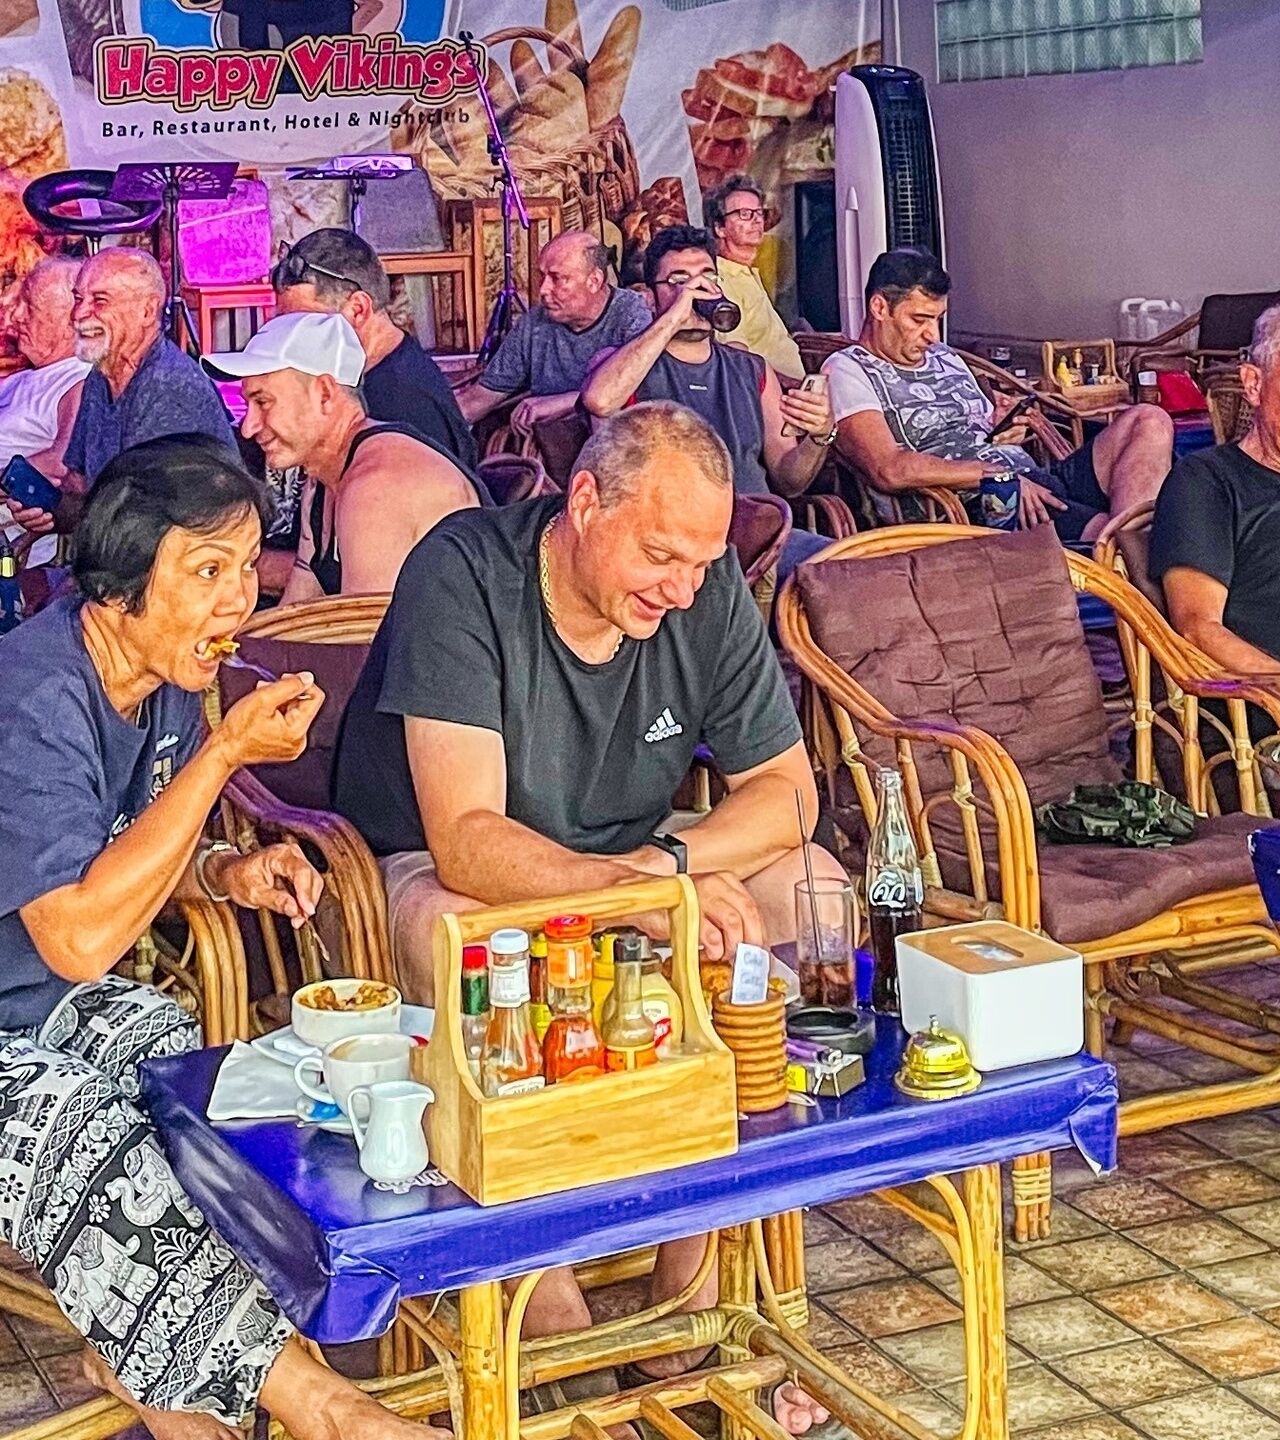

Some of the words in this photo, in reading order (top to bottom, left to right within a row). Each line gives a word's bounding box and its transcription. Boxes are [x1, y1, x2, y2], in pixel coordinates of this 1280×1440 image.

[102, 44, 281, 106] Happy
[289, 37, 483, 98] Vikings
[102, 122, 144, 138] Bar,
[152, 117, 277, 136] Restaurant,
[285, 113, 340, 130] Hotel
[348, 113, 361, 127] &
[369, 108, 471, 129] Nightclub
[644, 723, 683, 743] adidas
